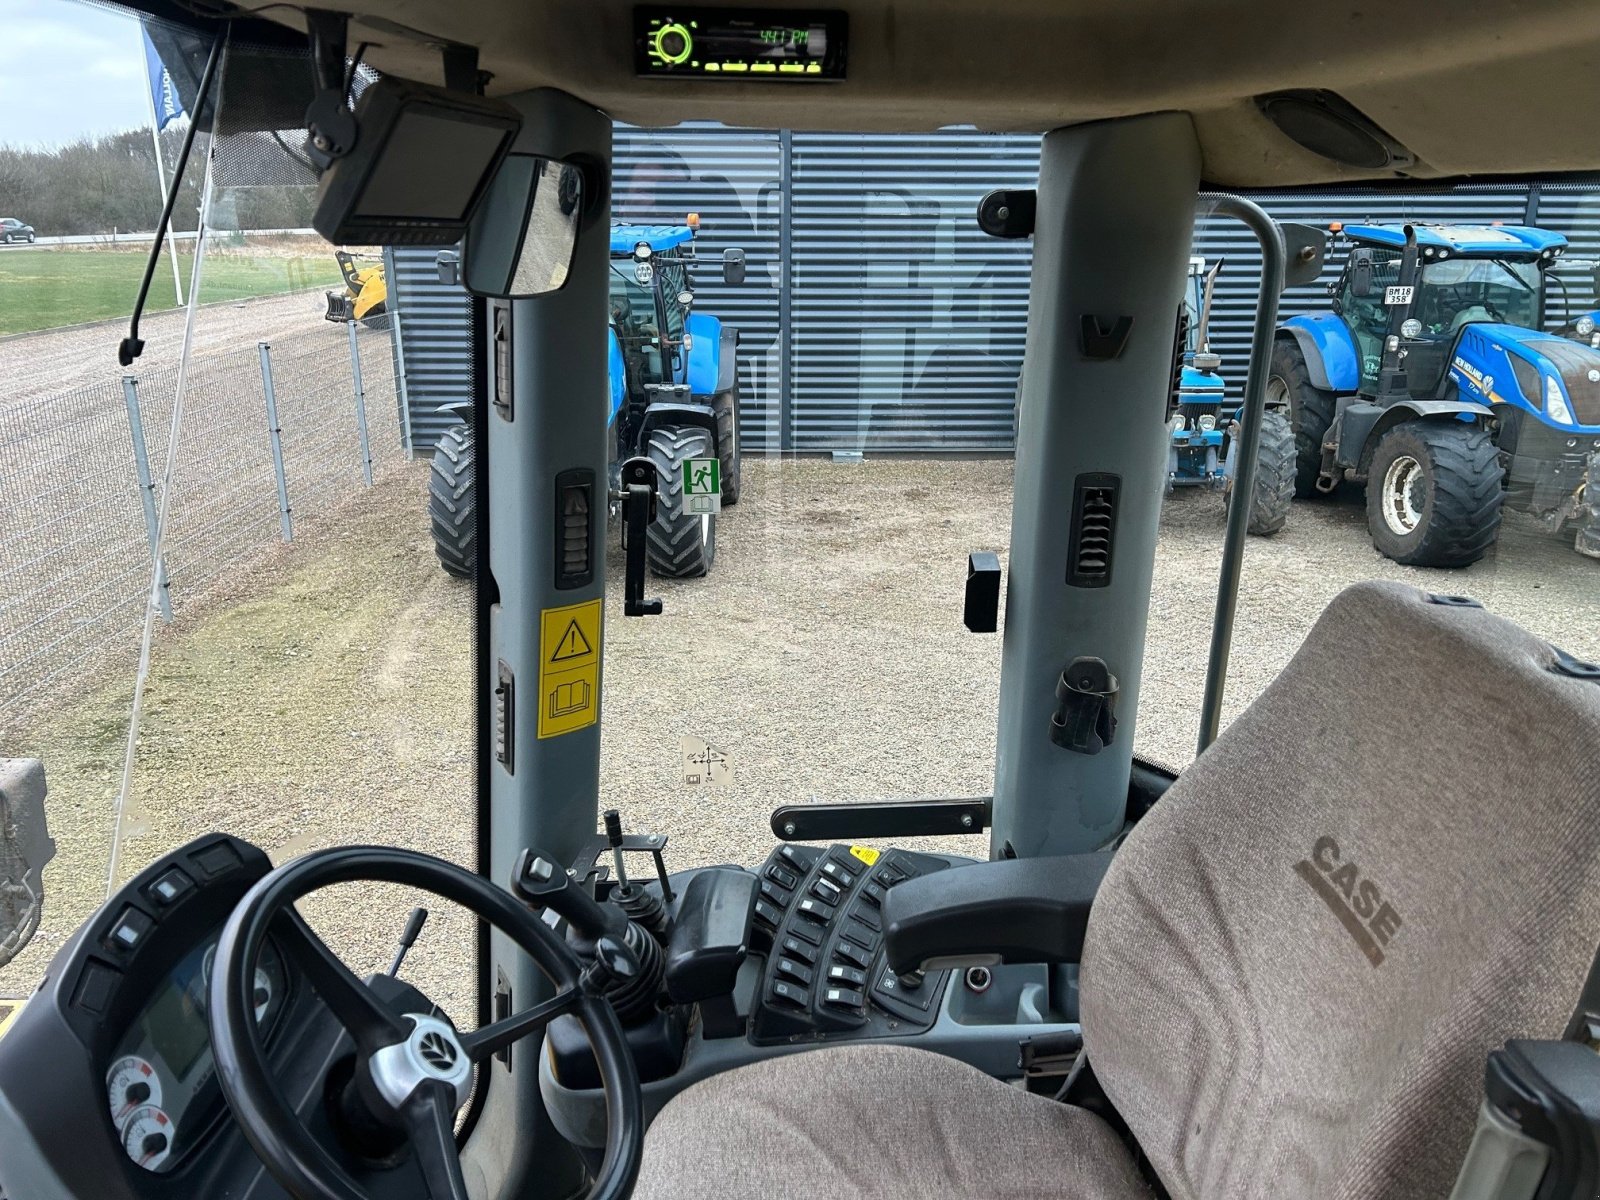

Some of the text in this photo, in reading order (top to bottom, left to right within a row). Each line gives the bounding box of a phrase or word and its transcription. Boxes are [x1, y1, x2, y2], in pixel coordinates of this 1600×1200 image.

[791, 30, 808, 44] PM
[1455, 356, 1464, 367] NEW
[1463, 361, 1483, 381] HOLLAND
[1313, 835, 1402, 946] CASE
